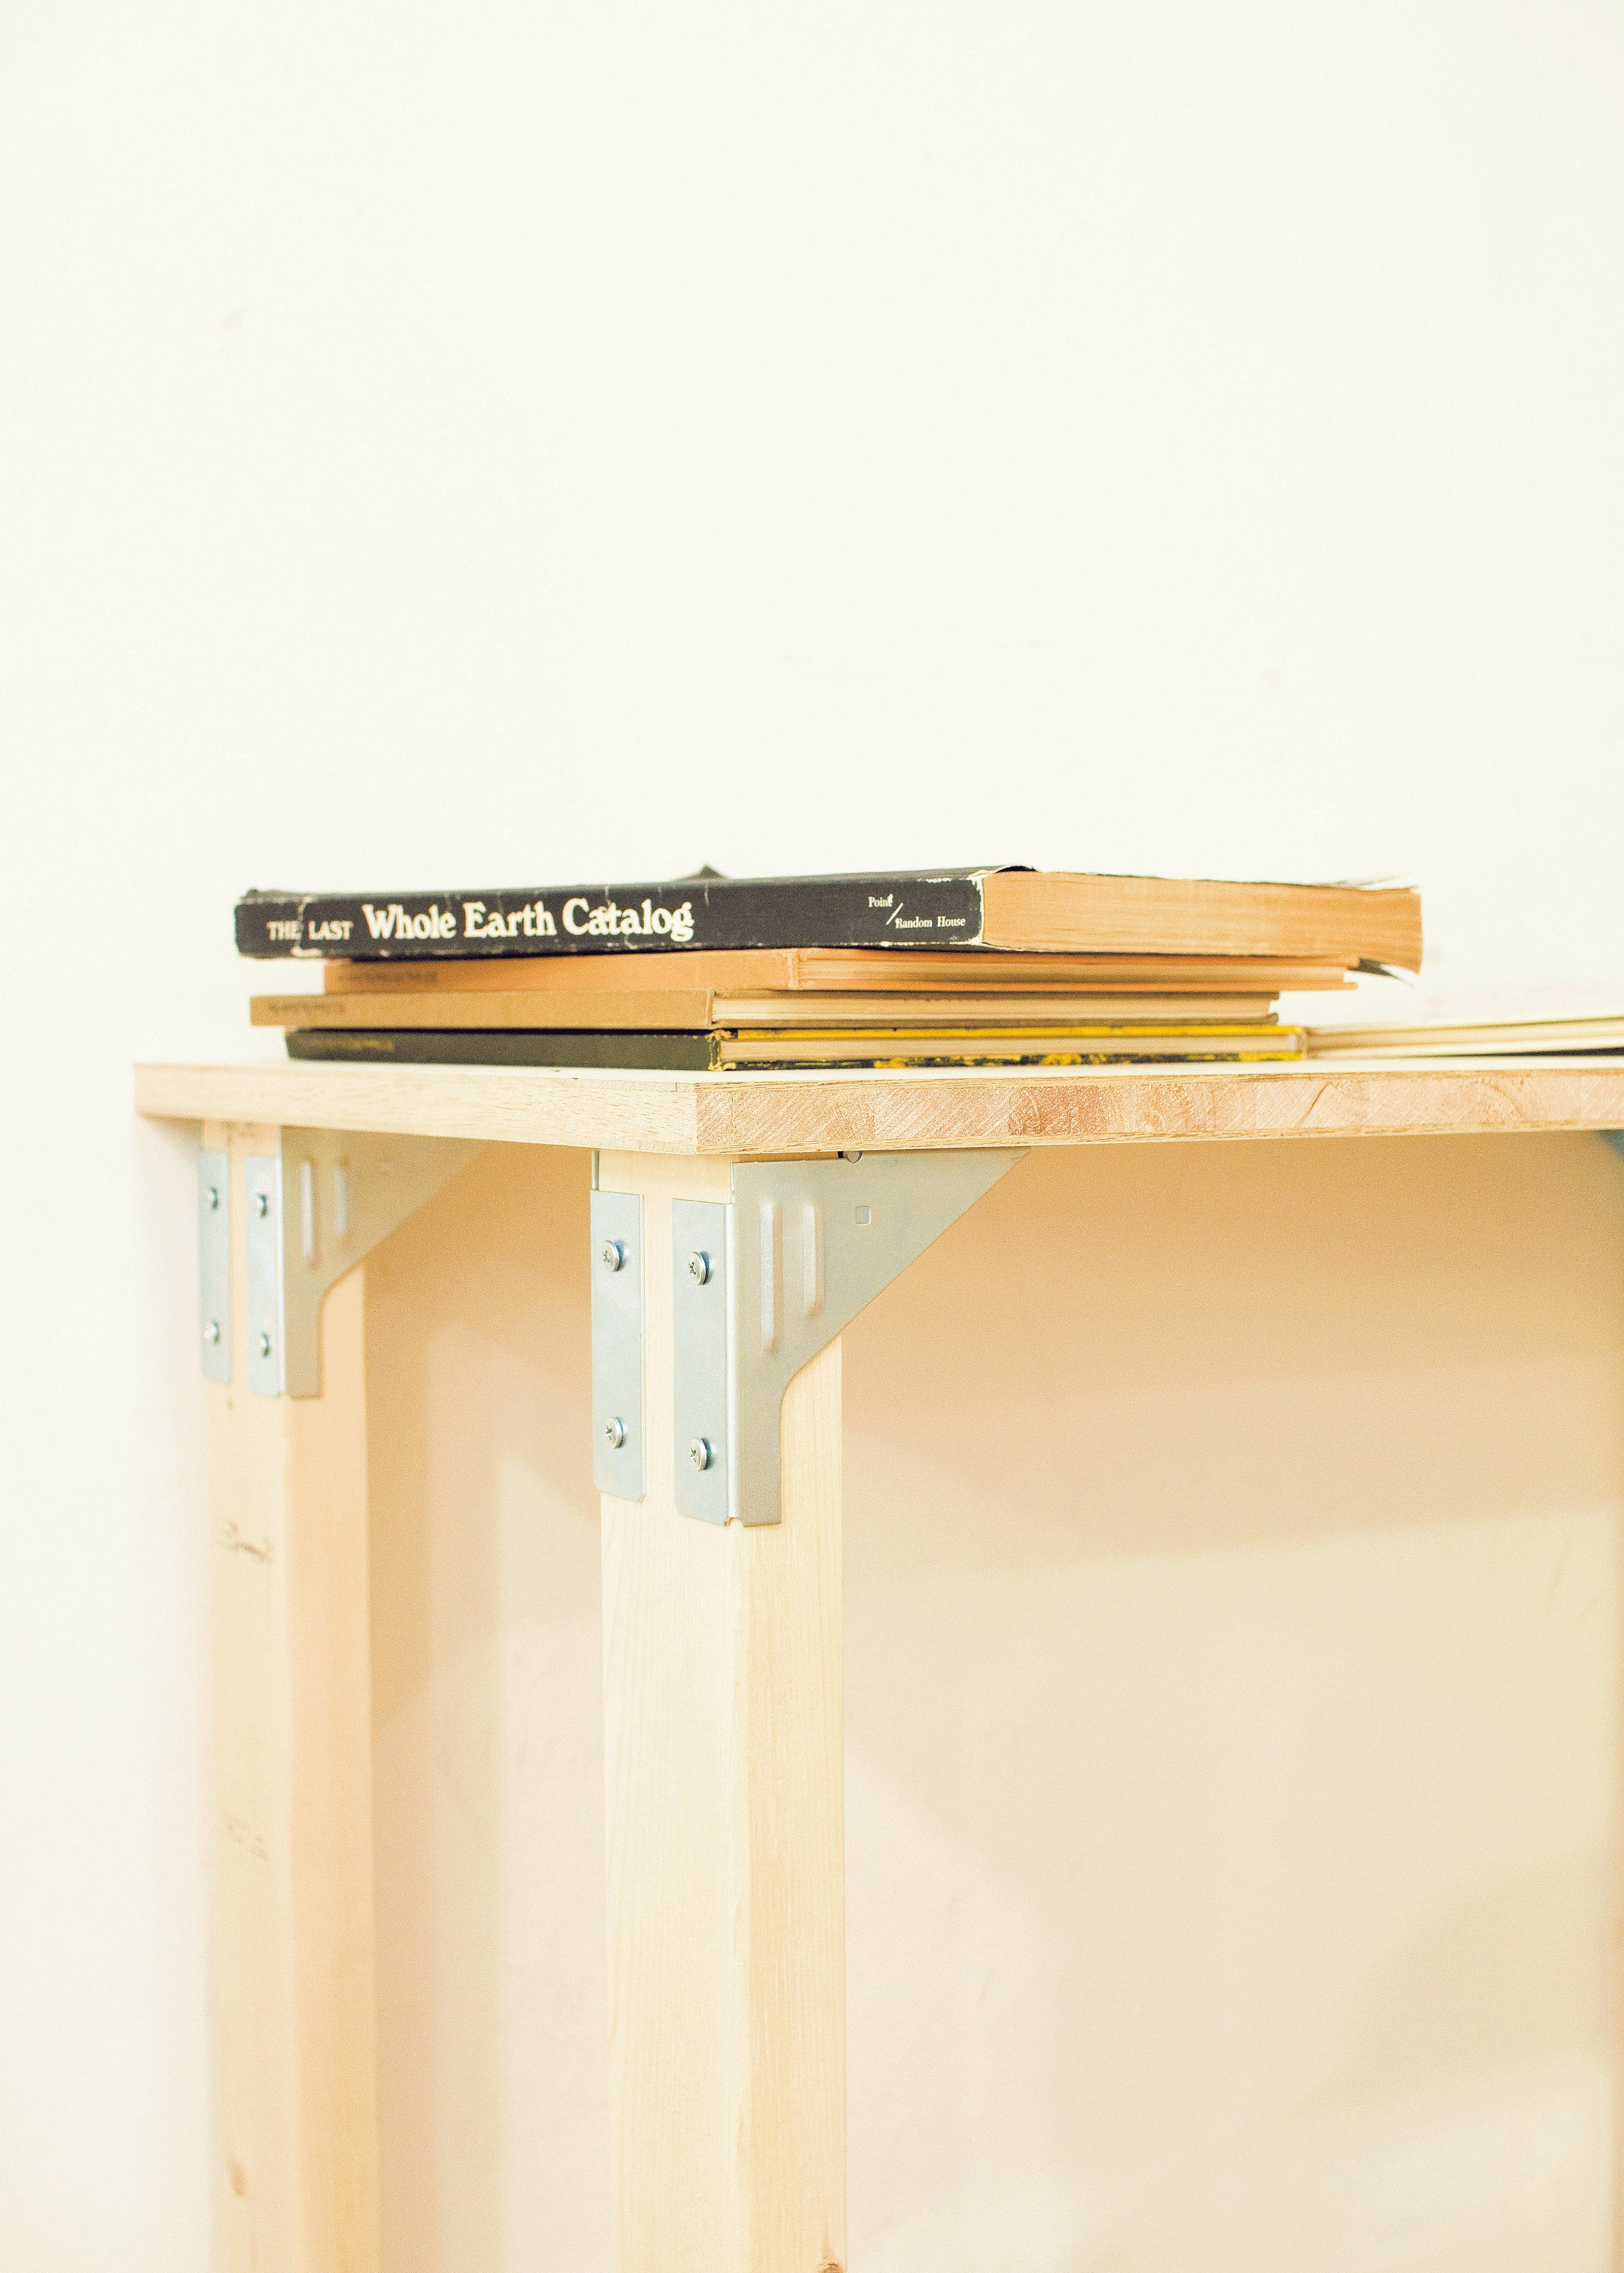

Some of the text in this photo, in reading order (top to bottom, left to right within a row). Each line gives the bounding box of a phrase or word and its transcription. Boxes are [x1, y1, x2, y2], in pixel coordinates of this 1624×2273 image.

[868, 894, 893, 907] Point
[308, 920, 353, 941] LAST
[362, 903, 456, 939] Whole
[463, 901, 557, 938] Earth
[562, 897, 695, 942] Catalog
[895, 916, 966, 929] Random House
